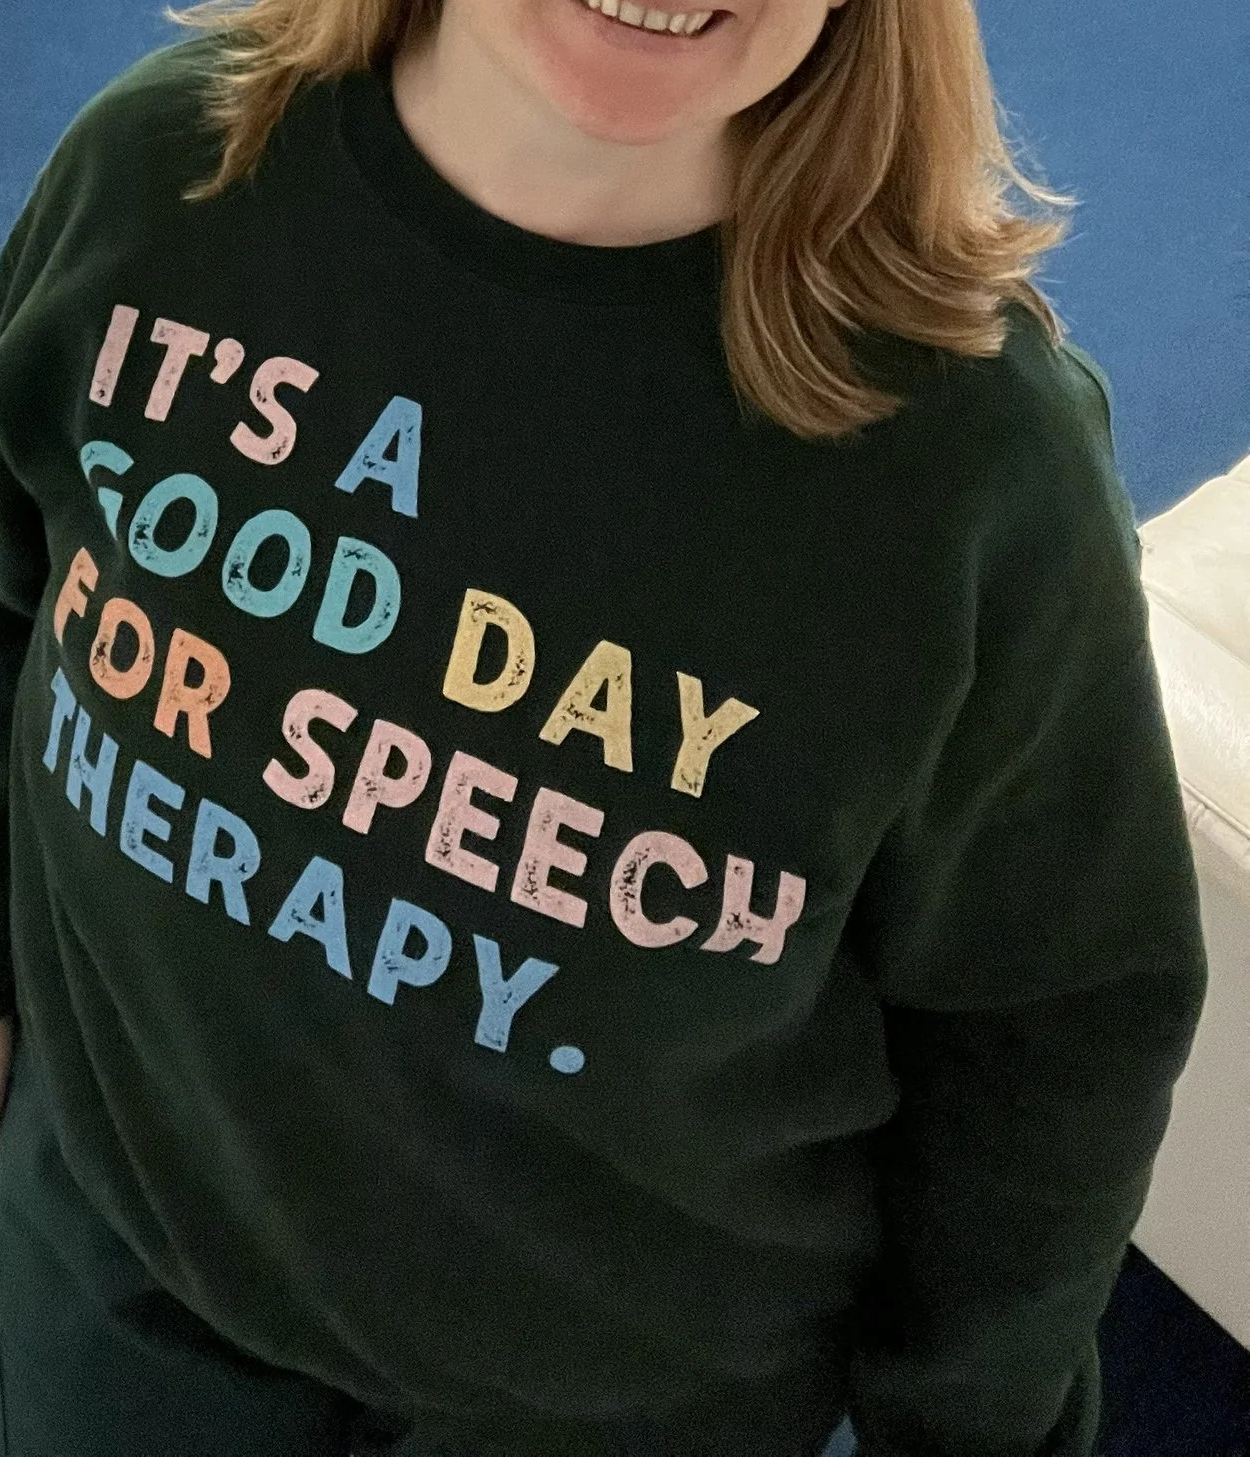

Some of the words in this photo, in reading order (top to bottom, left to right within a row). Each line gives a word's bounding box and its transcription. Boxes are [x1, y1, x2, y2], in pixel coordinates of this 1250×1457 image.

[88, 304, 320, 466] IT'S
[334, 395, 423, 518] A
[53, 546, 232, 759] FOR
[262, 688, 807, 965] SPEECH
[441, 587, 761, 799] DAY
[42, 666, 585, 1074] THERAPY.
